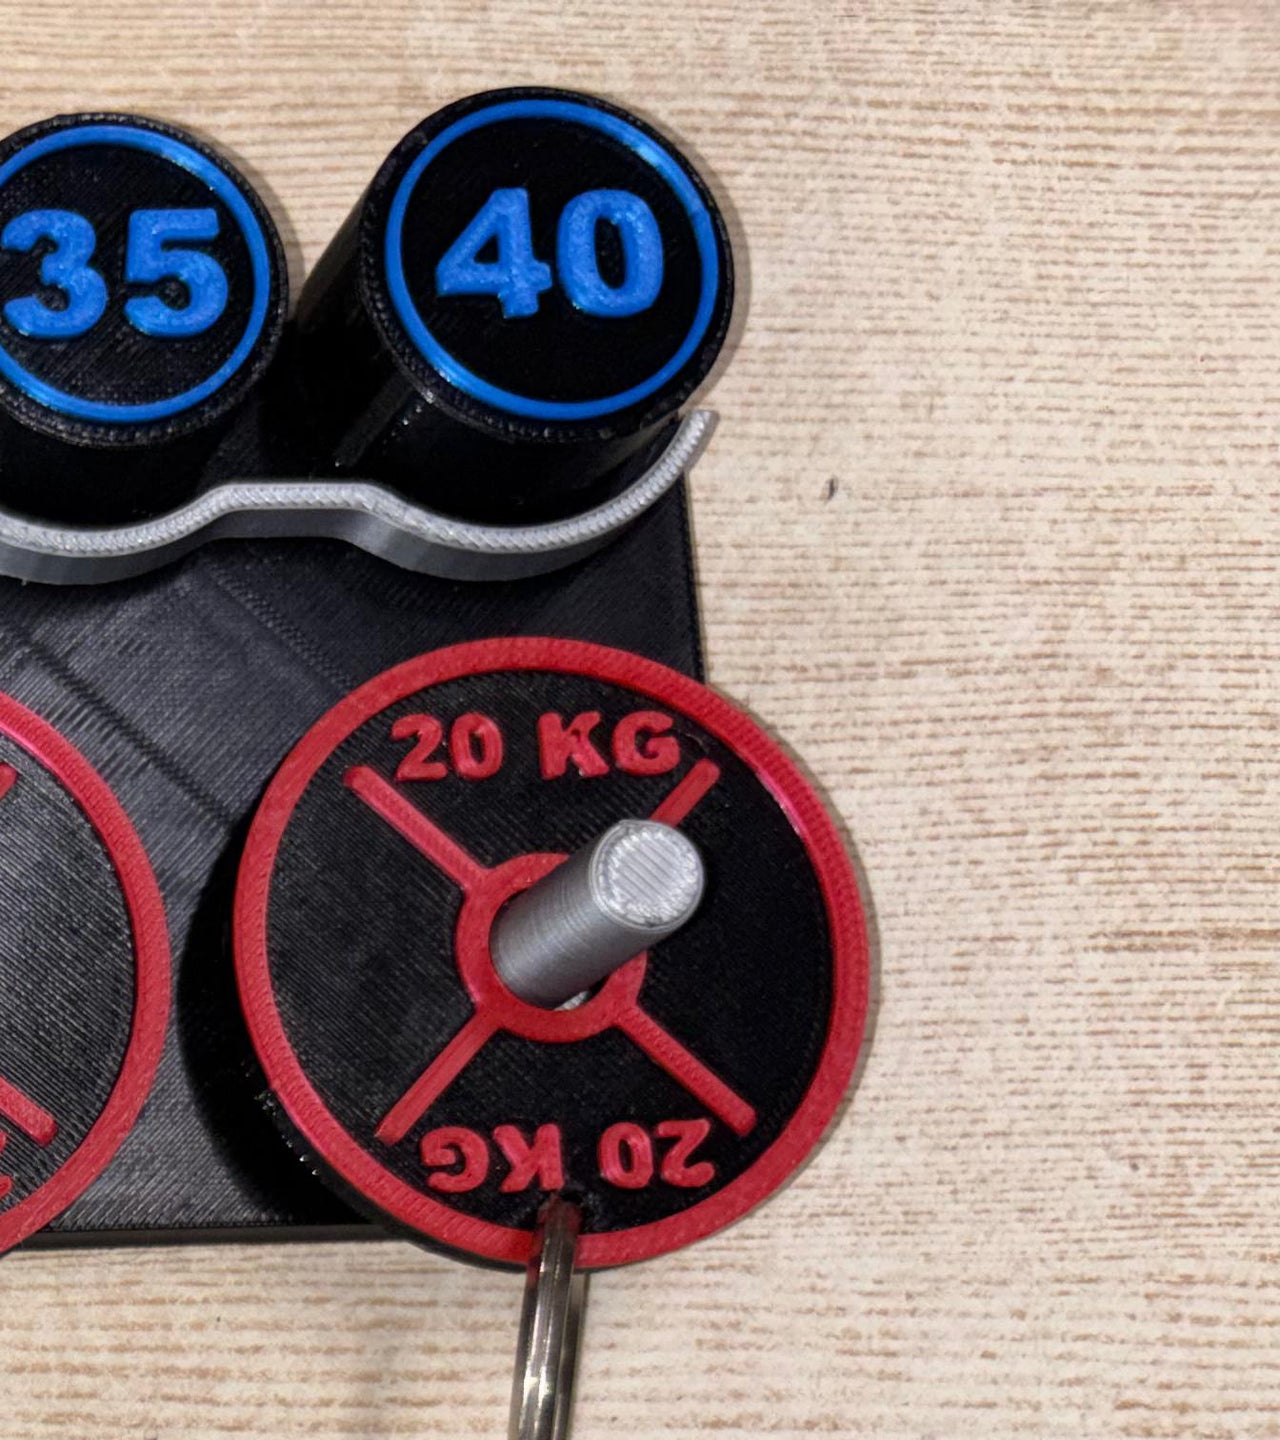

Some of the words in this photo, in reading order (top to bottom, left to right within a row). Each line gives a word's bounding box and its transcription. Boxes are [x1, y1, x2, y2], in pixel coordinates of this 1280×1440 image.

[0, 206, 229, 338] 35
[435, 187, 664, 319] 40
[391, 711, 504, 782] 20
[537, 710, 681, 780] KG
[420, 1123, 566, 1193] KG
[598, 1117, 716, 1189] 20
